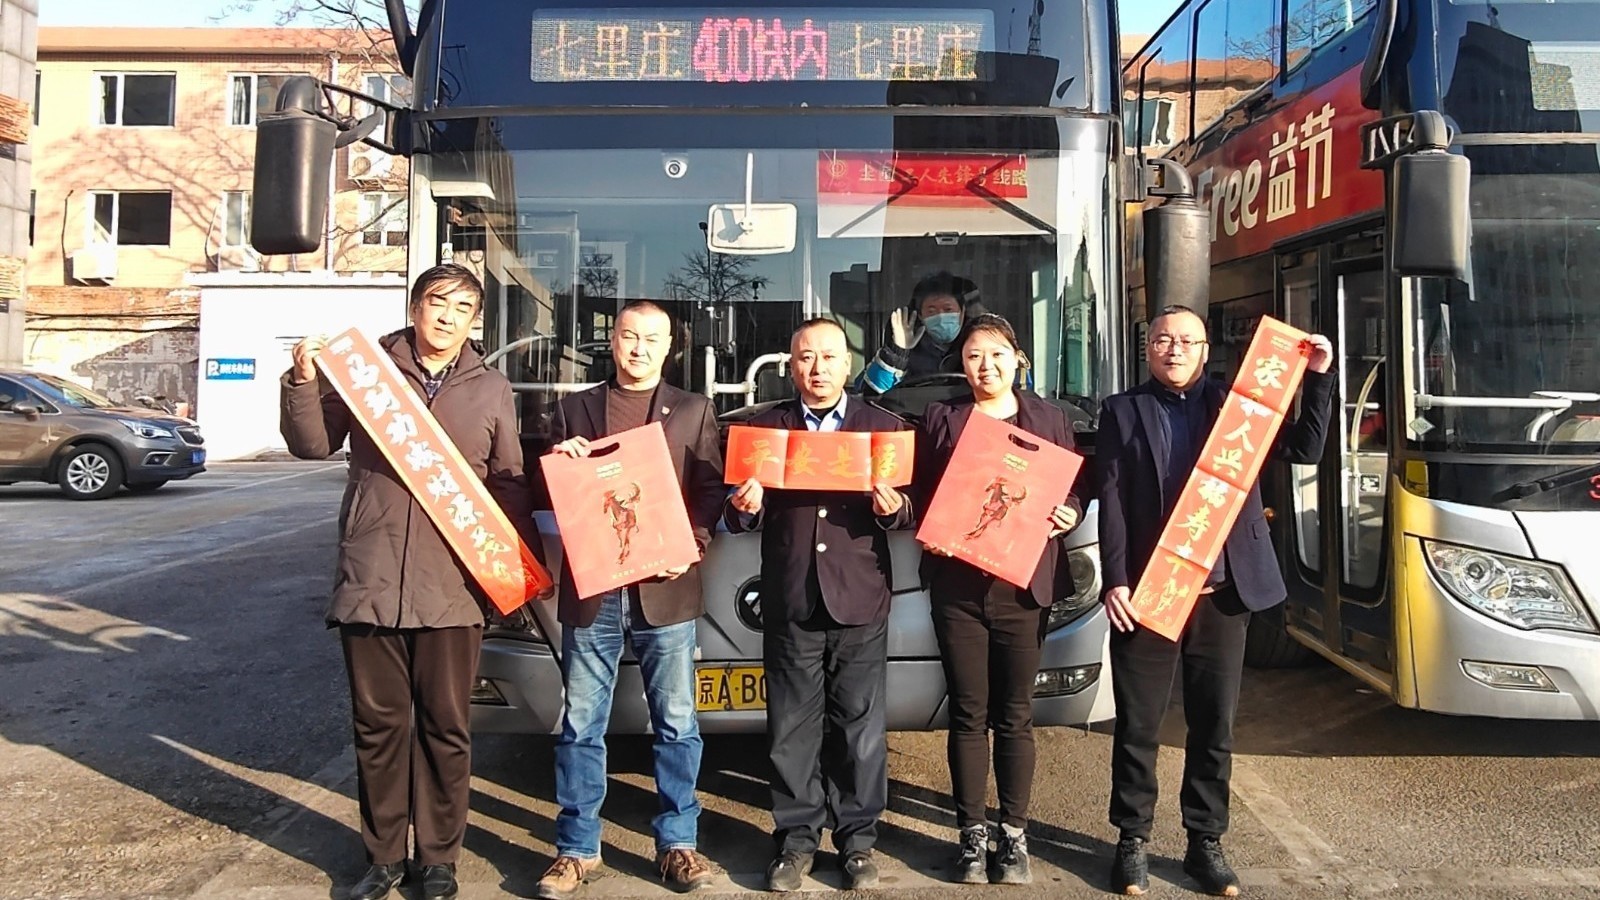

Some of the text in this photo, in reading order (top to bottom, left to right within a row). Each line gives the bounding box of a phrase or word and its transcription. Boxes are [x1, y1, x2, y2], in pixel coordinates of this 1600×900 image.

[540, 18, 978, 82] 七里庄 400快内 七里庄
